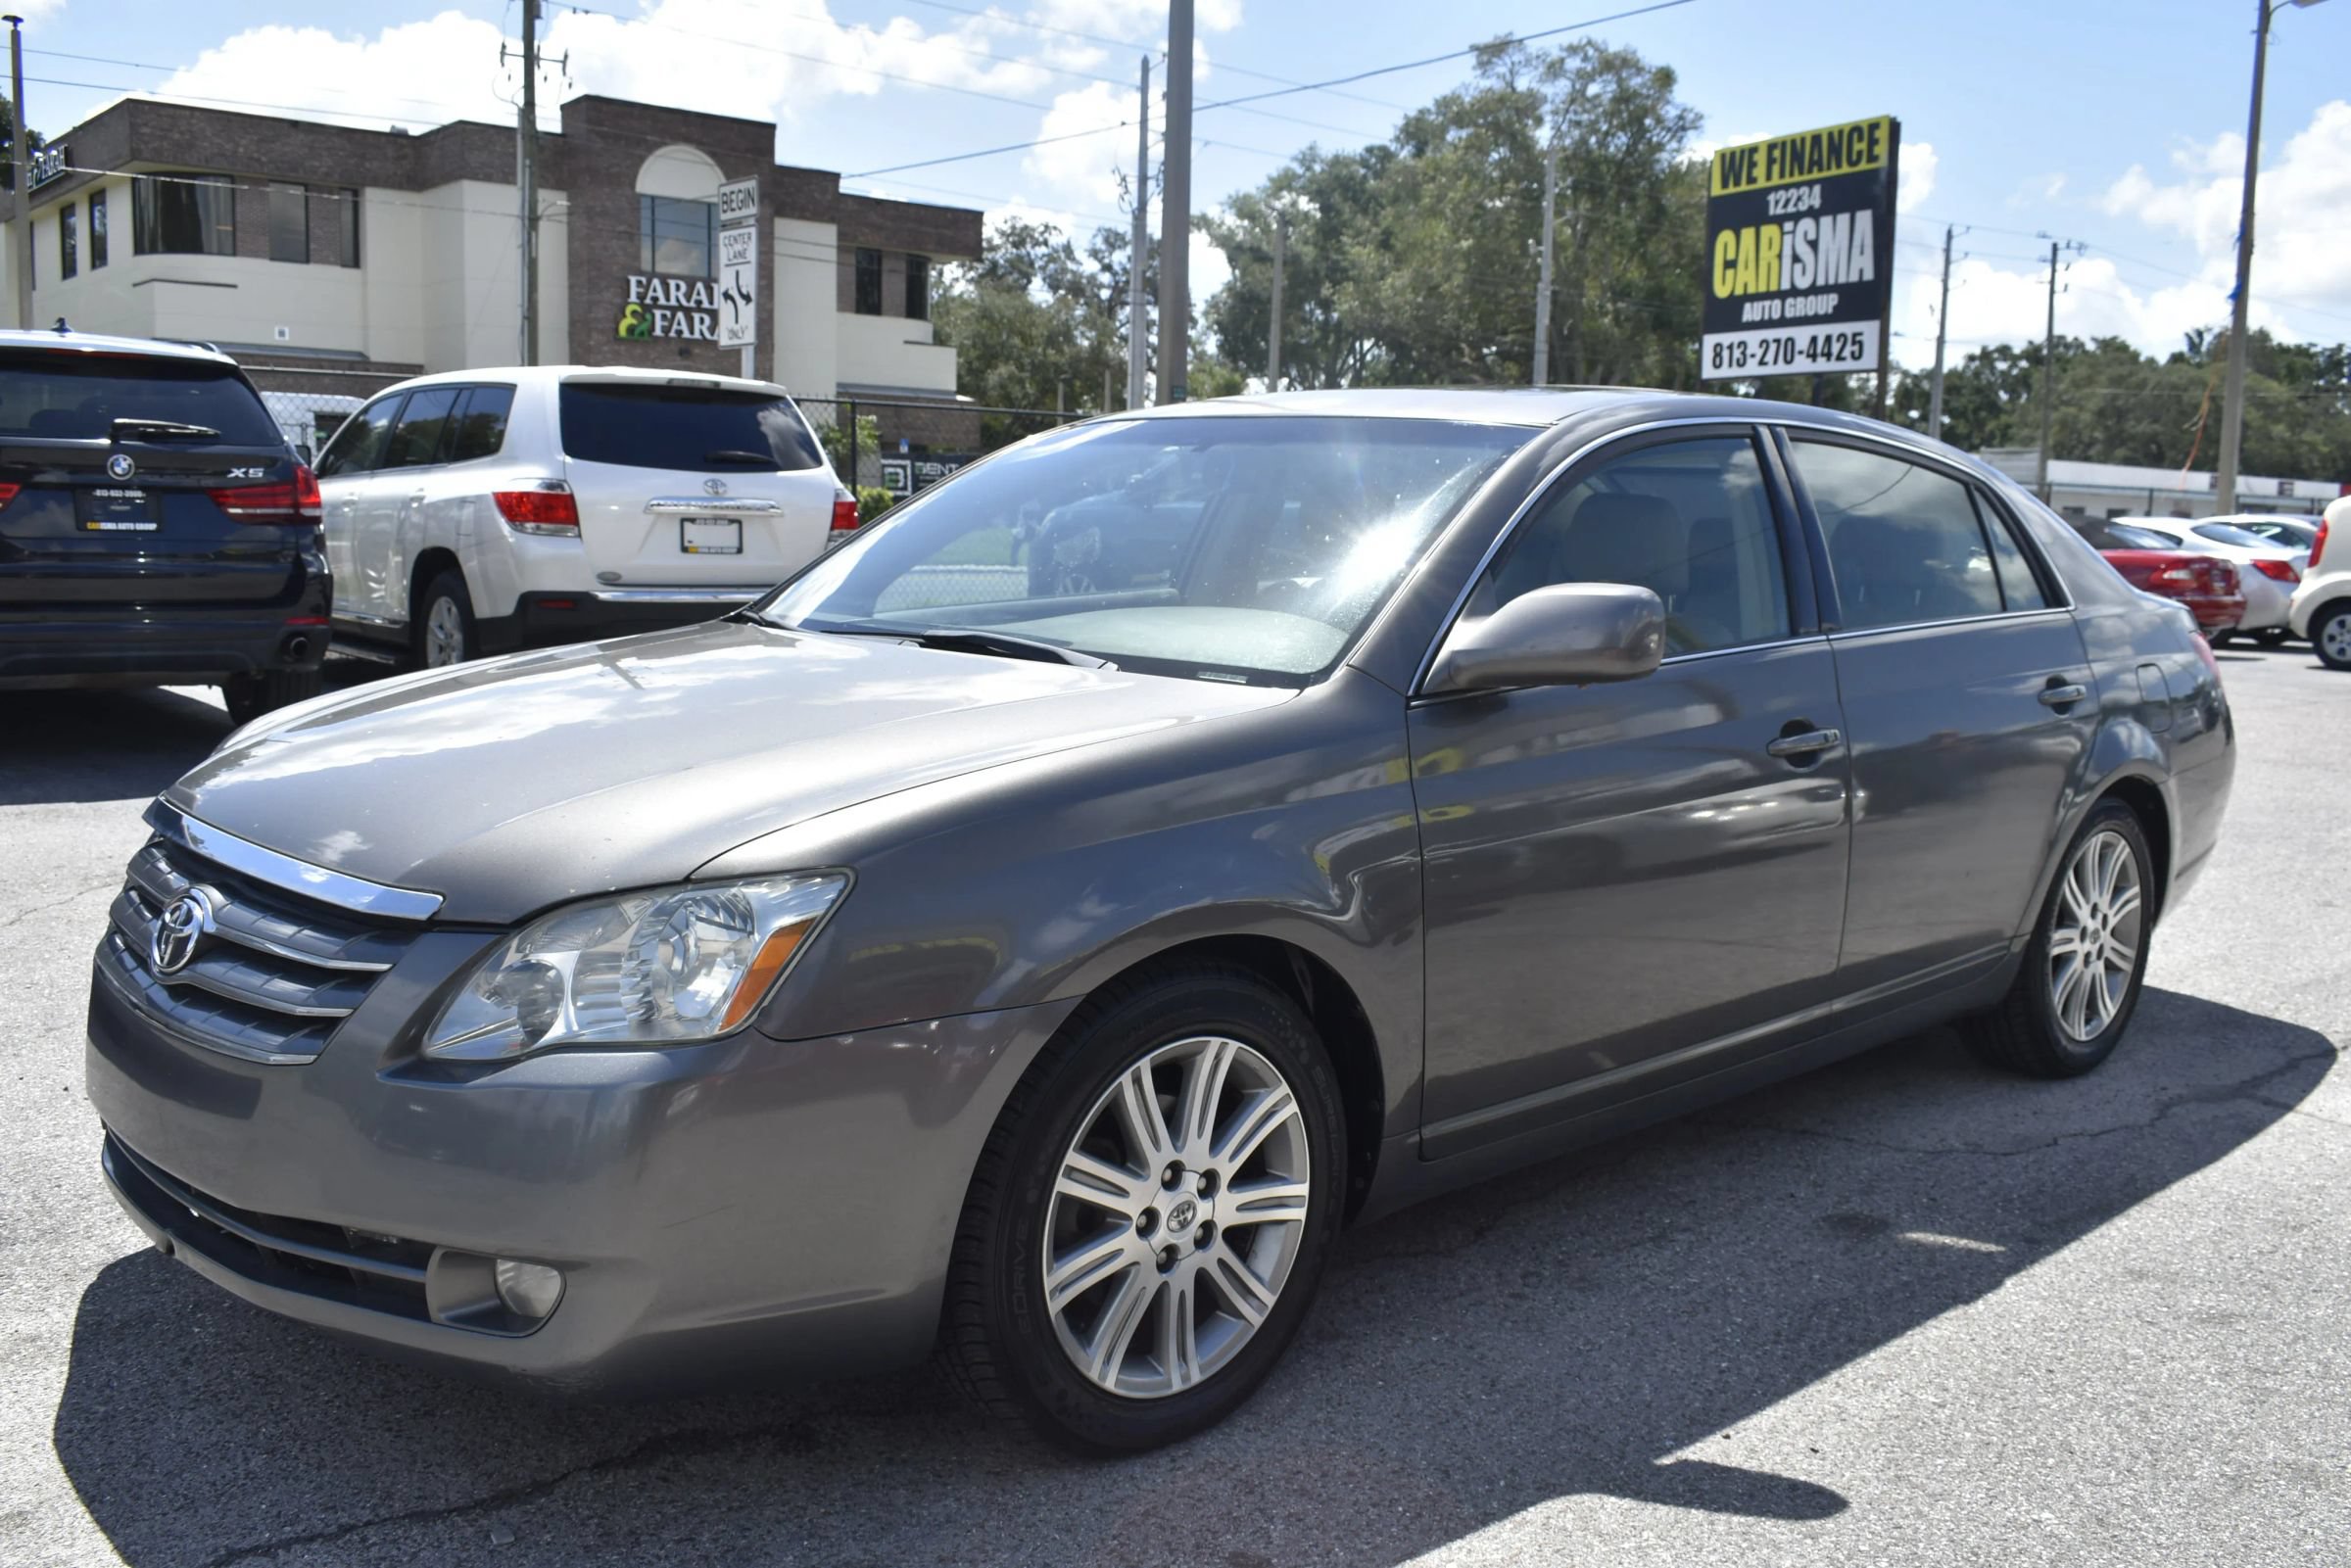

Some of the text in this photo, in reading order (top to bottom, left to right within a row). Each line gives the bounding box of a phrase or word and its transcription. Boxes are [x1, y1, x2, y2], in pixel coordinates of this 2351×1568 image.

[1720, 121, 1881, 190] WE FINANCE
[722, 186, 755, 214] BEGIN
[1767, 184, 1822, 215] 12234
[723, 231, 752, 247] CENTER
[727, 248, 747, 262] LANE
[1742, 293, 1839, 322] AUTO GROUP
[1712, 331, 1864, 369] 813-270-4425
[226, 467, 264, 478] X5
